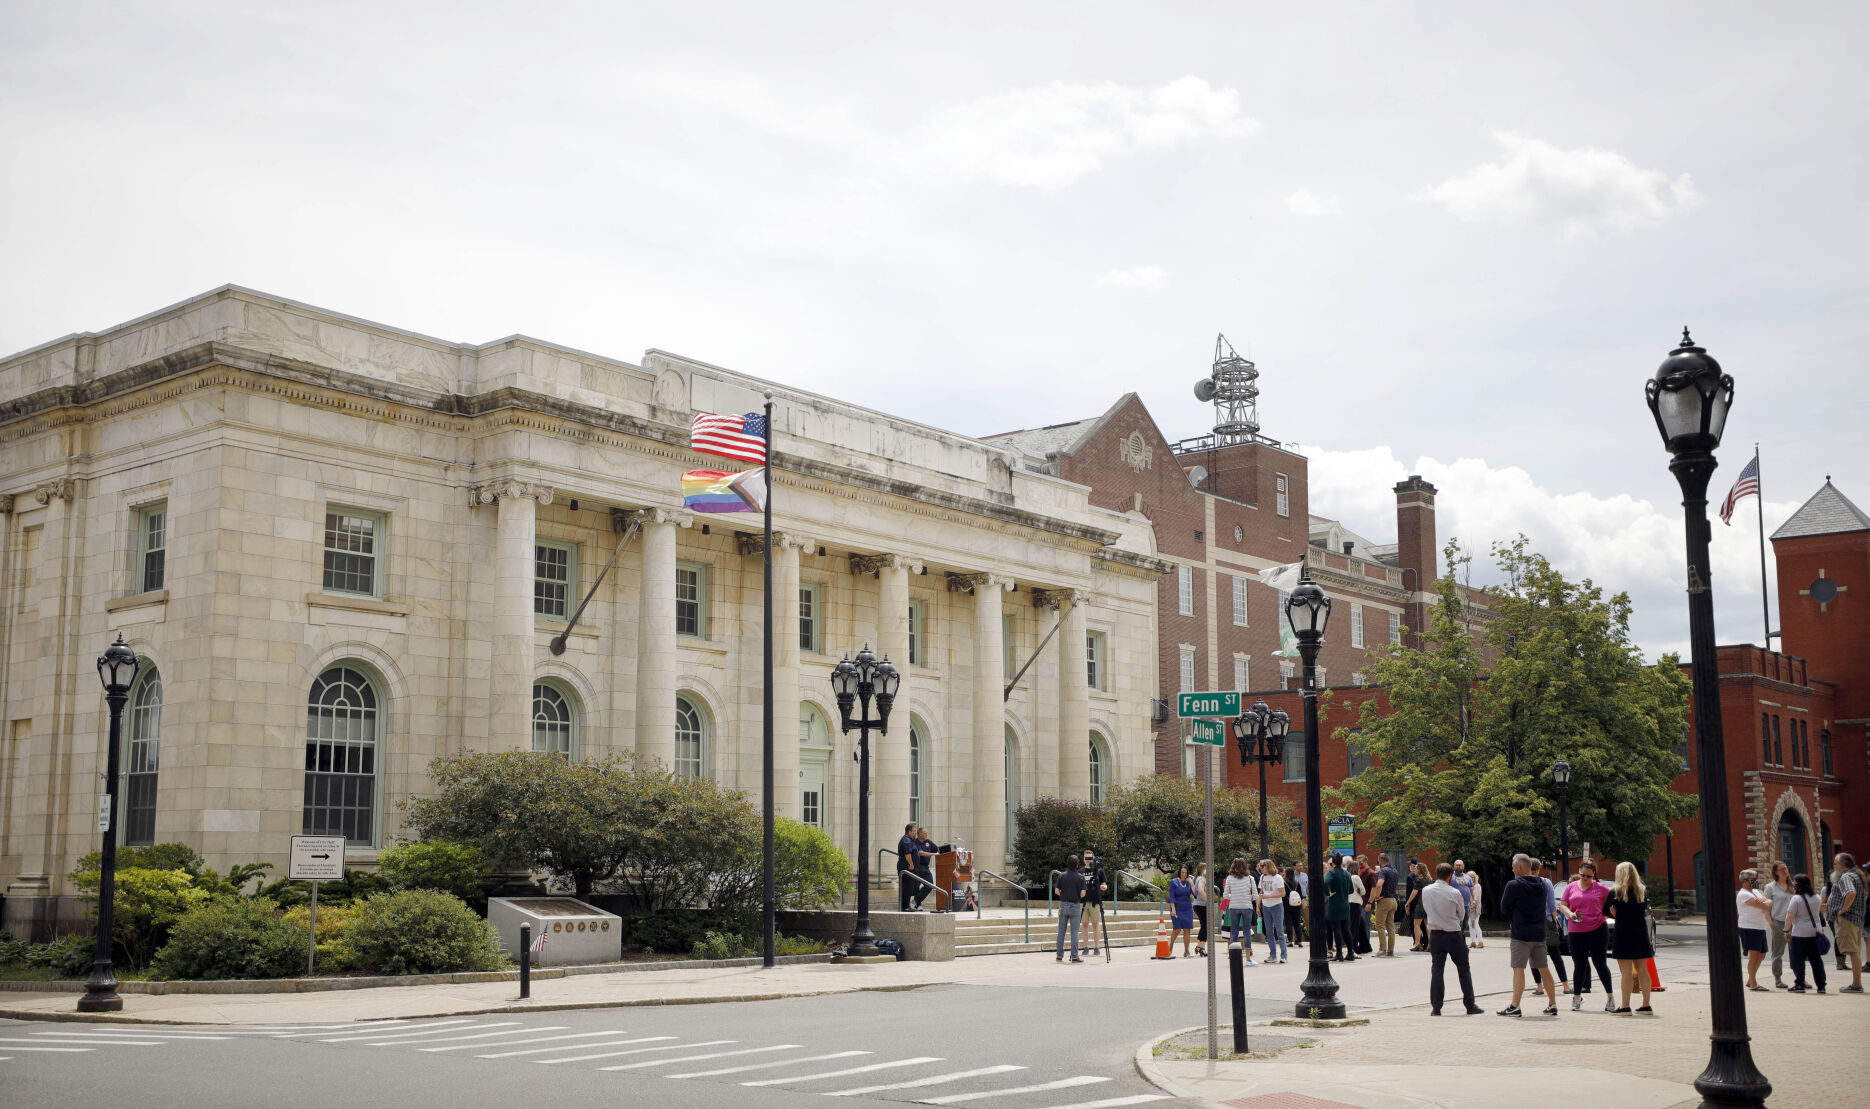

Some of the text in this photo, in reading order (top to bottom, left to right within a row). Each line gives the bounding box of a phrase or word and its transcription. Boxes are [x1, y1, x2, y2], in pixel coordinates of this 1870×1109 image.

[1183, 694, 1236, 712] Fenn ST
[1193, 722, 1222, 740] Allen ST
